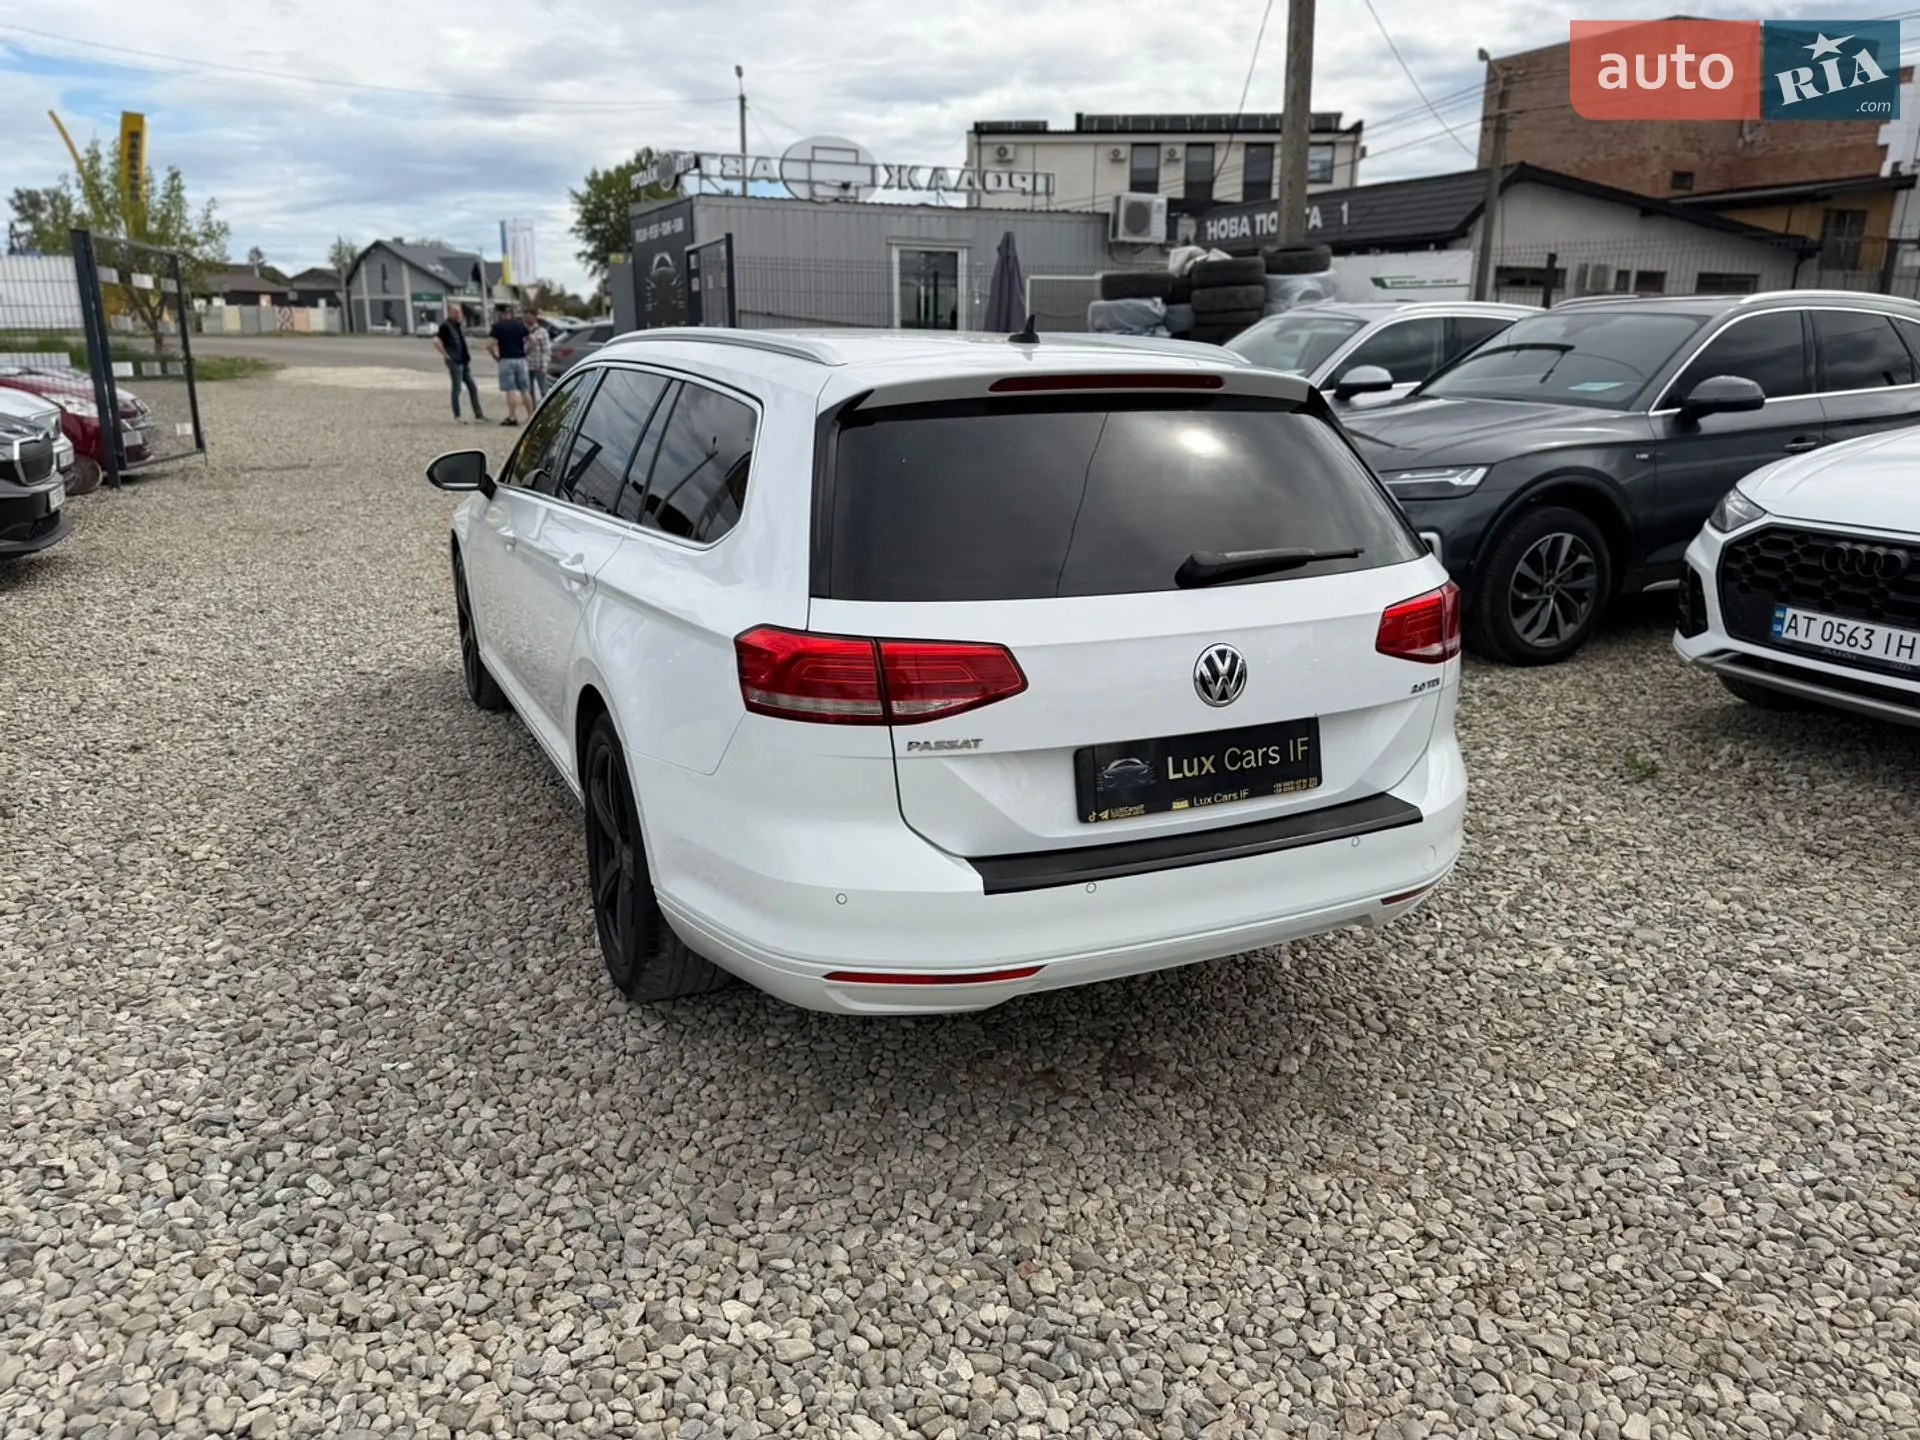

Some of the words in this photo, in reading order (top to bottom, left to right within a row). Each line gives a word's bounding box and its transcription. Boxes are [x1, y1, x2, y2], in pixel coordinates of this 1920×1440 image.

[1206, 215, 1250, 241] НОВА
[1254, 206, 1323, 236] ПОА
[1341, 201, 1349, 225] 1
[1785, 613, 1817, 639] AT
[1821, 620, 1876, 651] 0563
[1884, 632, 1917, 660] IH
[907, 738, 983, 752] PASSAT
[1167, 755, 1216, 780] Lux
[1224, 746, 1280, 771] Cars
[1289, 736, 1309, 762] IF
[1193, 796, 1212, 807] Lux
[1214, 791, 1238, 803] Cars
[1240, 788, 1250, 798] IF
